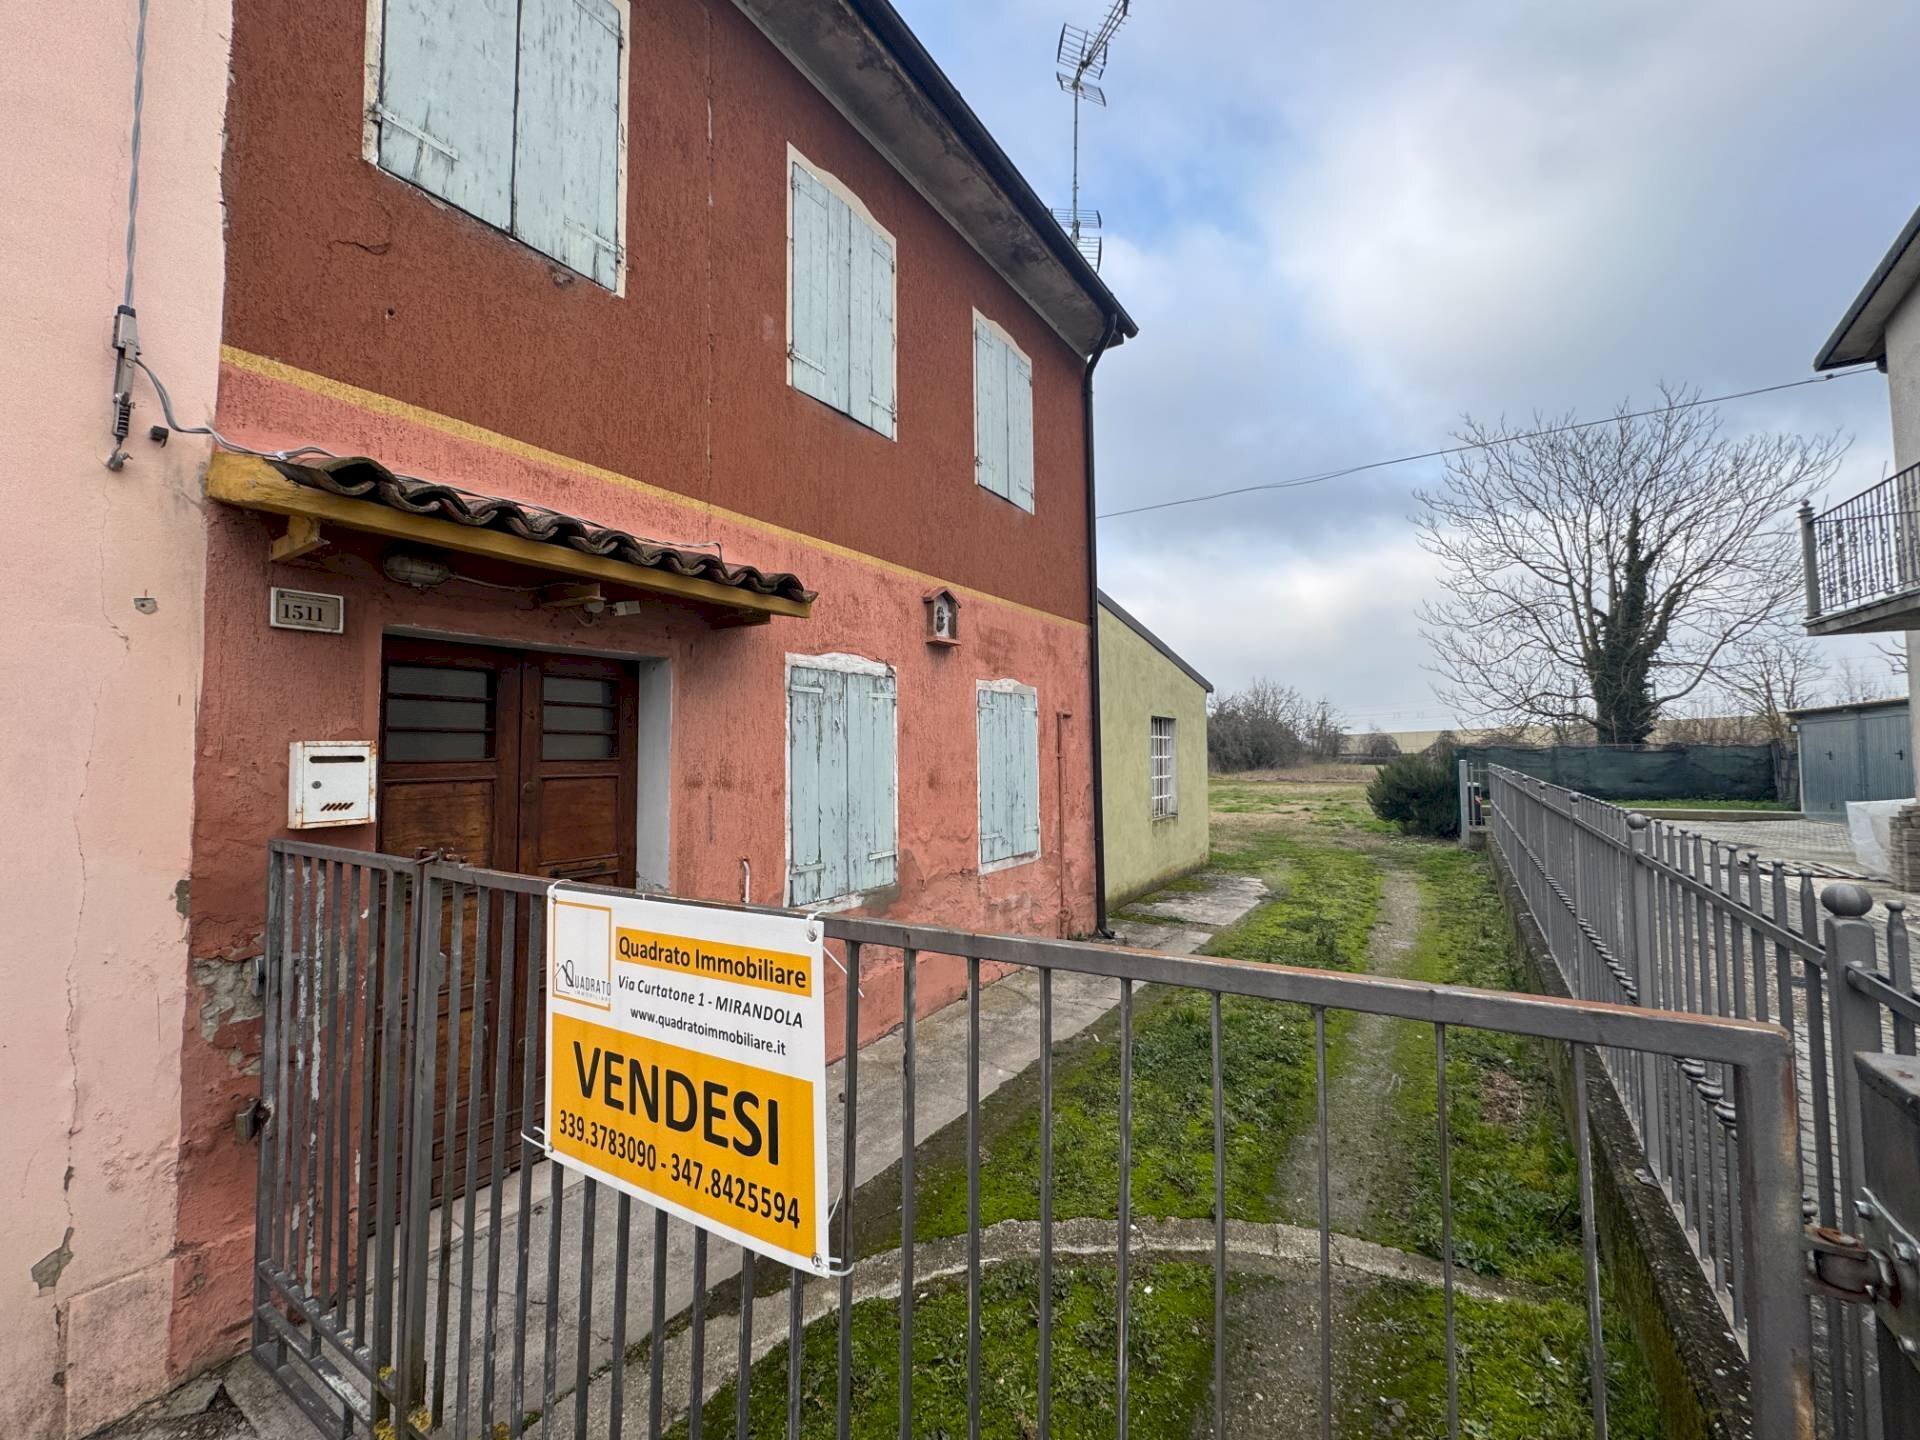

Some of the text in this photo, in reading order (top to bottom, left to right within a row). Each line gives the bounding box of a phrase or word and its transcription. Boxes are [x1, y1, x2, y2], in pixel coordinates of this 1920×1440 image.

[282, 604, 322, 621] 1511
[564, 959, 611, 996] QUADRATO
[619, 936, 806, 989] Quadrato Immobiliare
[618, 975, 635, 990] Via
[637, 979, 695, 1005] Curtatone
[698, 993, 704, 1007] 1
[715, 996, 803, 1028] MIRANDOLA
[630, 1008, 786, 1056] www.quadratoimmobiliare.it
[573, 1041, 779, 1165] VENDESI
[560, 1110, 656, 1172] 339.3783090
[671, 1154, 800, 1229] 347.8425594
